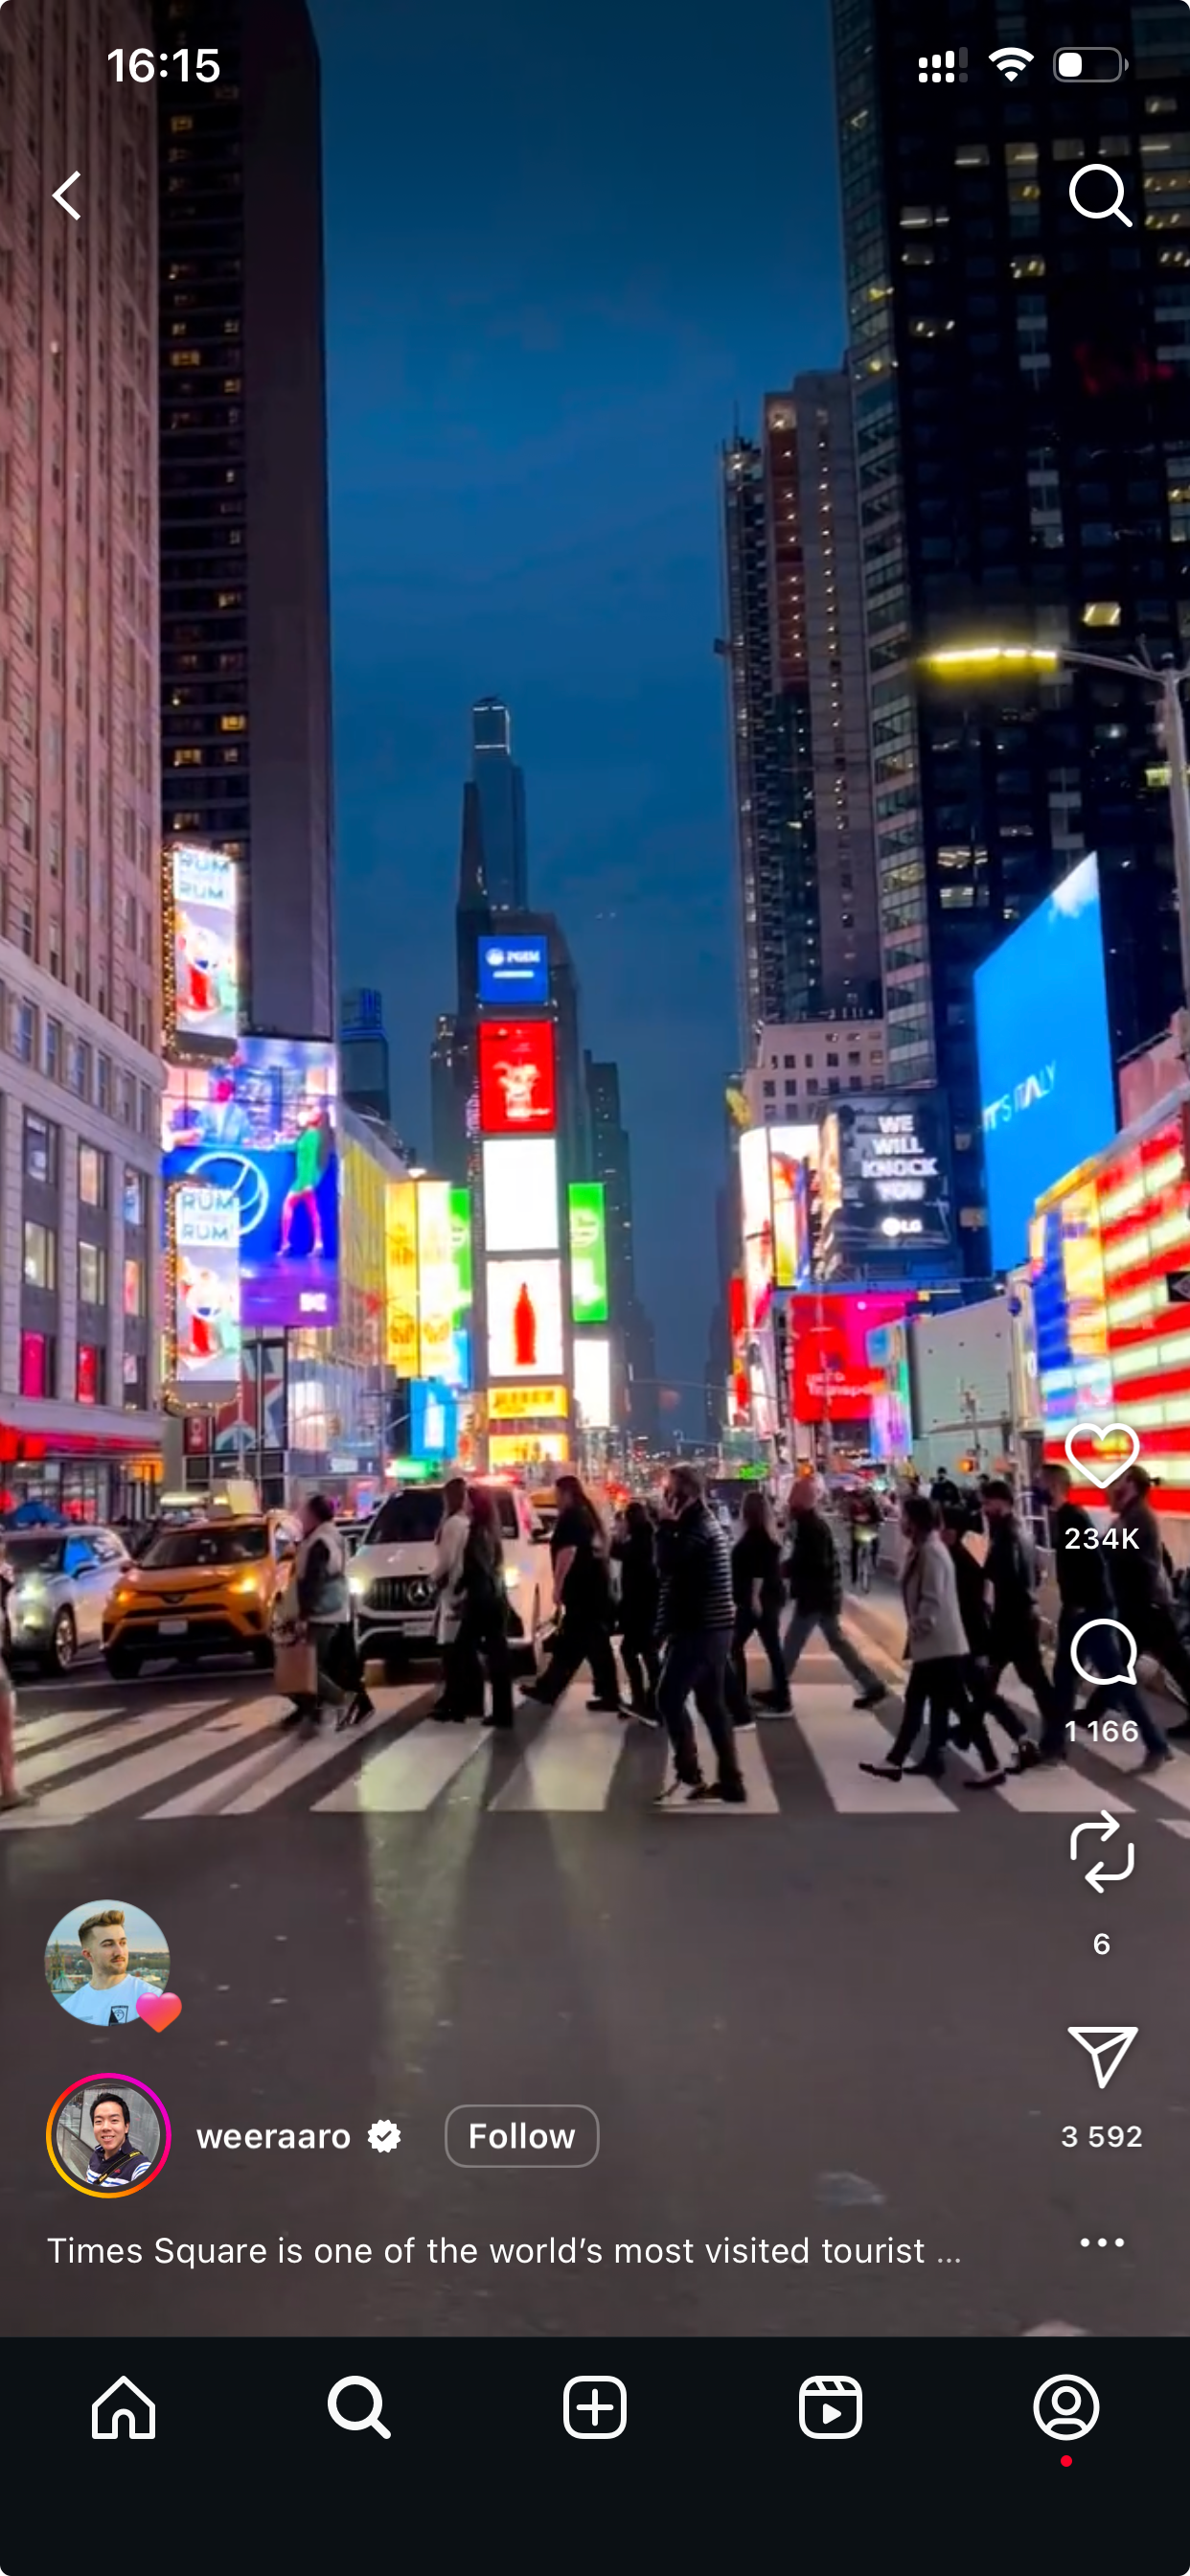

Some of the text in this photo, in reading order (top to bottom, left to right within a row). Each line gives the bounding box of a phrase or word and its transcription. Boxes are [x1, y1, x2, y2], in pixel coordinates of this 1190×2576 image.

[878, 1115, 914, 1133] WE
[872, 1137, 925, 1155] WILL
[861, 1157, 938, 1178] KNOCK
[875, 1180, 926, 1202] YOU
[182, 1192, 233, 1210] RUM
